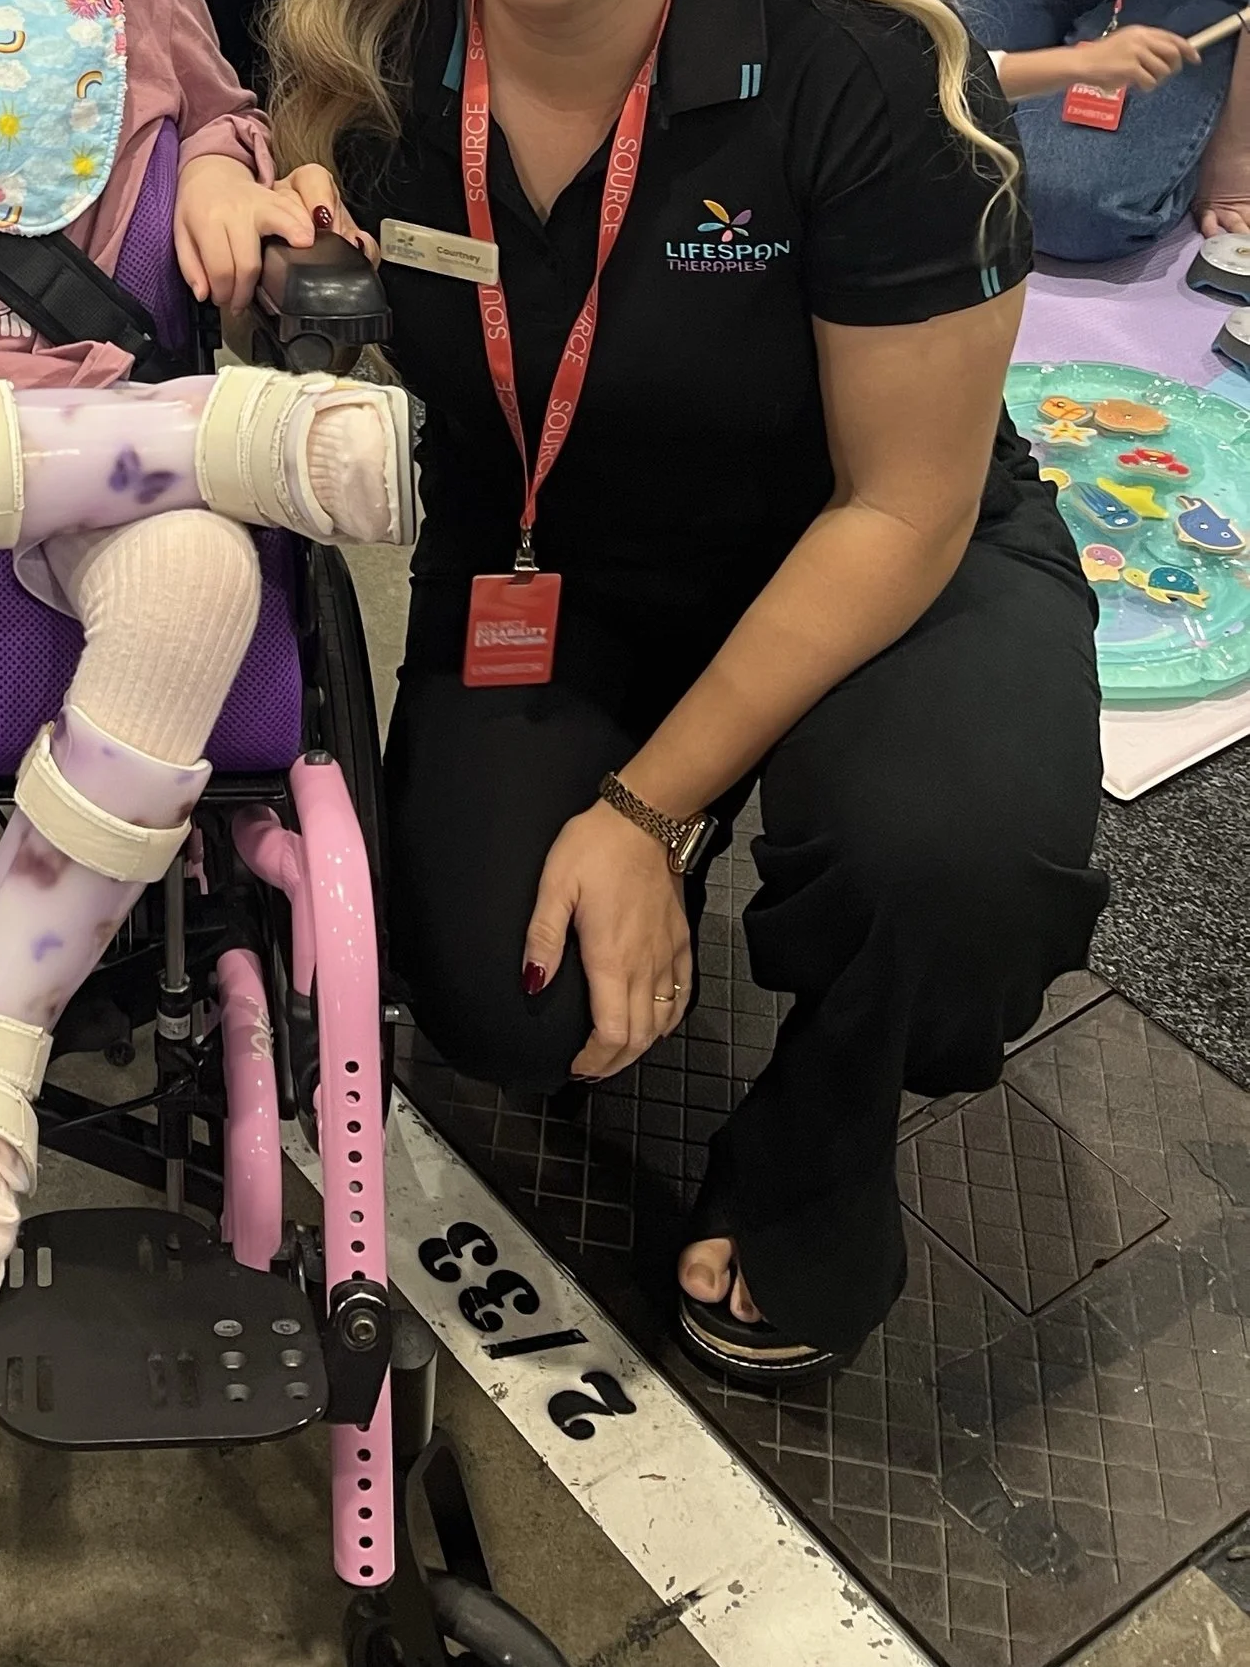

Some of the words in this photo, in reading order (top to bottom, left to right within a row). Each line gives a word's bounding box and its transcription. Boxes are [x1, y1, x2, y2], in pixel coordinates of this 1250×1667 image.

[465, 103, 487, 202] SOURCE
[603, 135, 638, 235] SOURCE
[436, 246, 480, 264] Courtney
[666, 240, 790, 260] LIFESPAN
[667, 259, 767, 273] THERAPIES
[482, 290, 507, 340] SOU
[565, 303, 594, 367] URCE
[539, 399, 572, 474] SOURC
